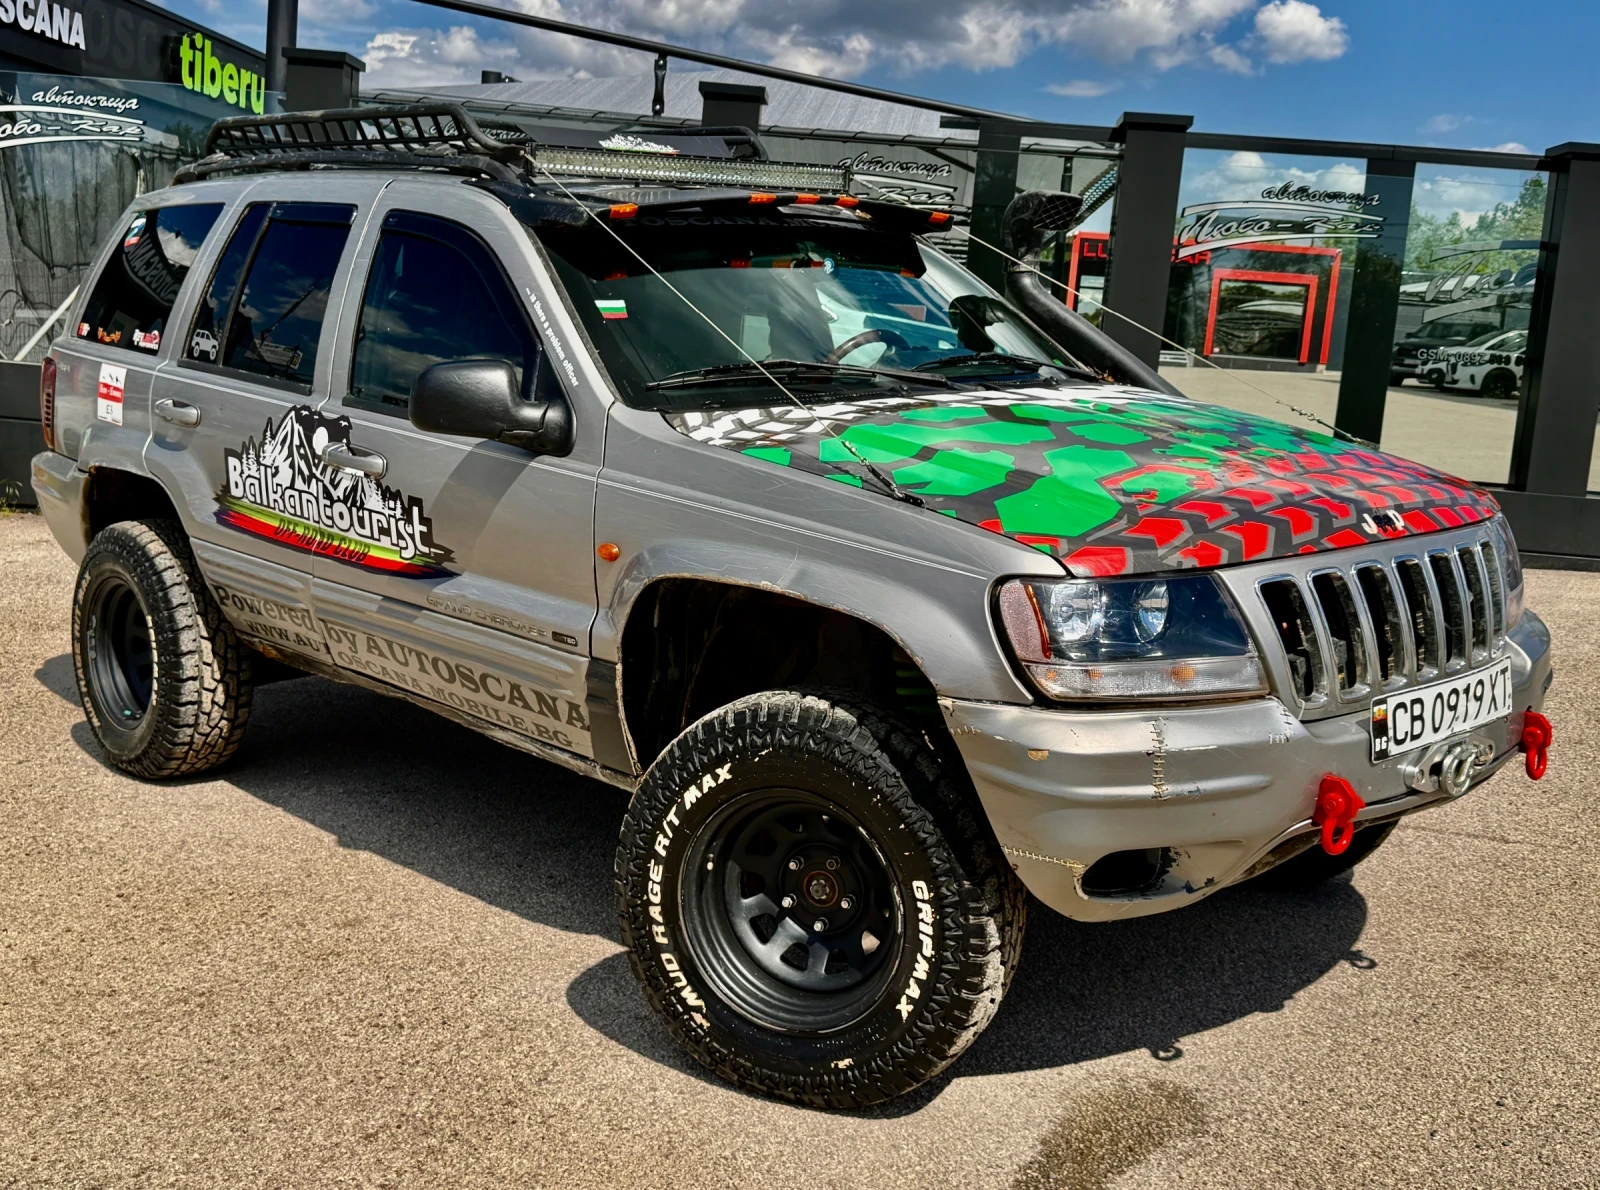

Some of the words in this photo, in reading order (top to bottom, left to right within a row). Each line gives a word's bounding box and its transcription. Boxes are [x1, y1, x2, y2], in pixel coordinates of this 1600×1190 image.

[32, 86, 139, 113] автокъща
[71, 120, 145, 135] Кар
[1178, 210, 1272, 244] Любо
[545, 327, 566, 361] problem
[563, 360, 579, 387] officer
[227, 456, 429, 560] Balkantourist
[274, 517, 335, 551] OFF-ROAD
[333, 536, 371, 562] CLUB
[427, 596, 472, 616] GRAND
[476, 609, 548, 637] CHEROKEE
[211, 583, 320, 635] Powered
[322, 620, 359, 655] by
[365, 635, 590, 733] AUTOSCANA
[1392, 697, 1425, 746] CB
[1431, 679, 1485, 734] 0919
[1487, 665, 1509, 715] XT
[1375, 736, 1388, 752] BG
[684, 762, 733, 811] MAX
[654, 804, 680, 857] R/T
[647, 859, 669, 945] RAGE
[895, 880, 935, 1024] GRIPMAX
[660, 953, 707, 1014] MUD
